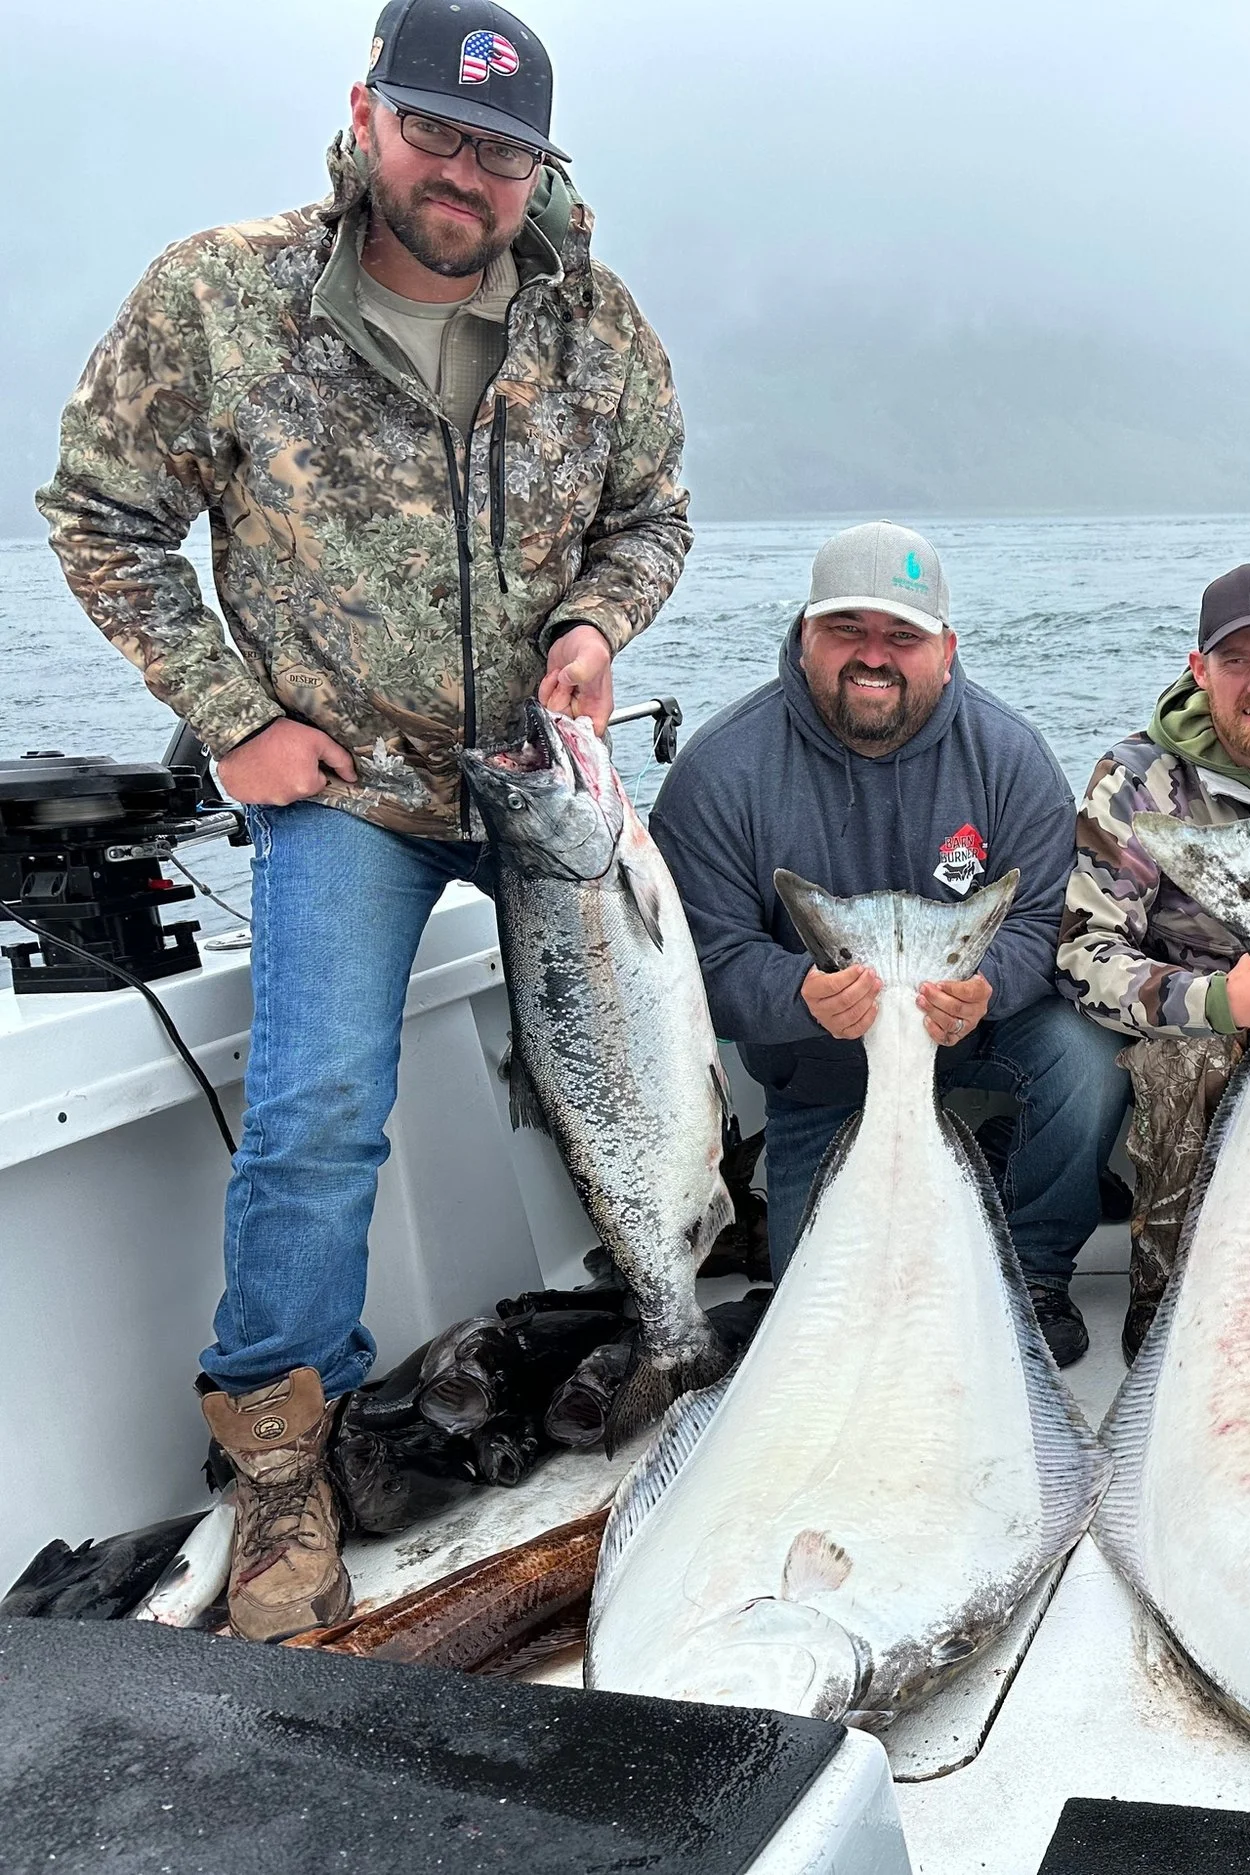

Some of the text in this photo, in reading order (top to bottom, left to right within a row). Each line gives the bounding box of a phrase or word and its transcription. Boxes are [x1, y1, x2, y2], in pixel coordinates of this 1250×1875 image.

[289, 674, 318, 685] DESERT
[945, 835, 976, 849] BARN
[940, 847, 979, 863] BURNER
